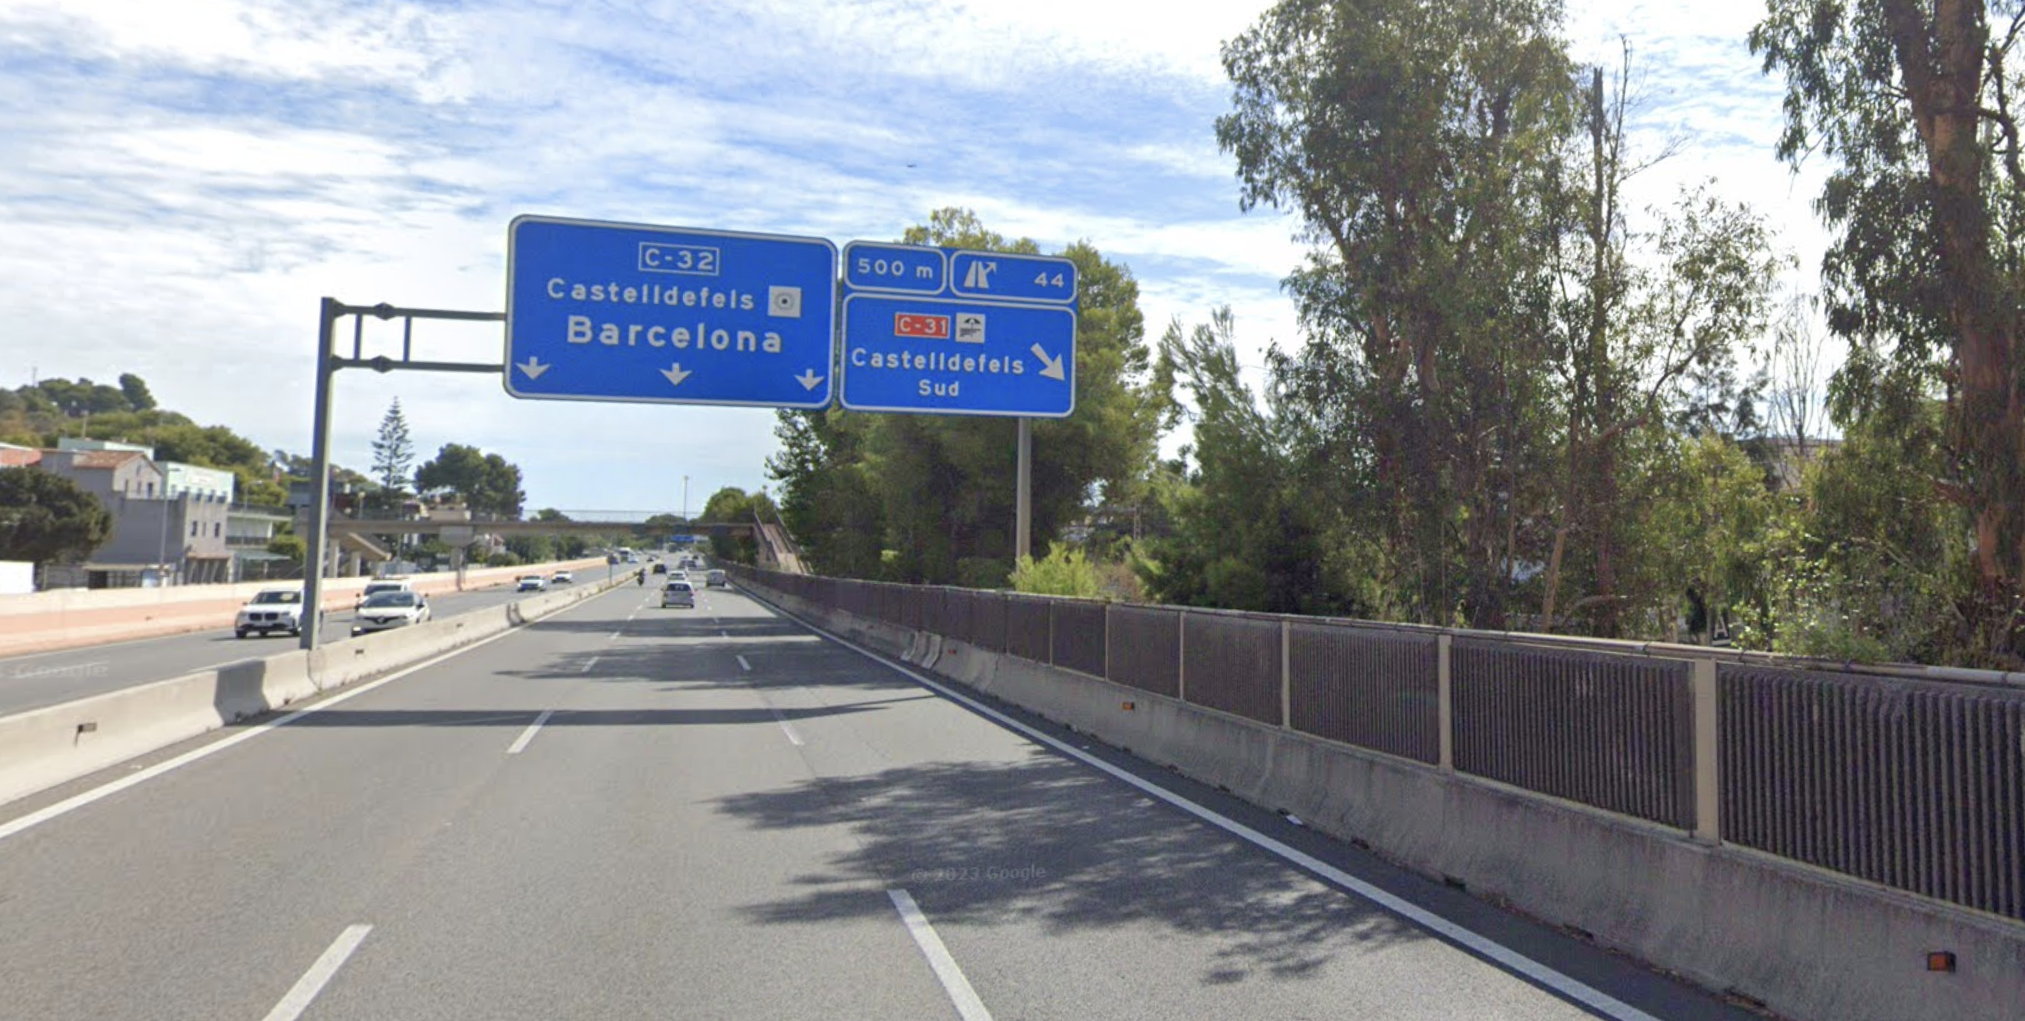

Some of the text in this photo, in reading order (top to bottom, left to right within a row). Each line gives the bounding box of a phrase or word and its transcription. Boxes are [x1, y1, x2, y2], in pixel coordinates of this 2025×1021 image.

[644, 248, 714, 270] C-32
[857, 258, 933, 279] 500 m
[1034, 272, 1064, 288] 44
[547, 278, 755, 310] Castelldefels
[566, 315, 783, 353] Barcelona
[899, 317, 947, 335] C-31
[851, 347, 1025, 375] Castelldefels
[918, 379, 960, 397] Sud
